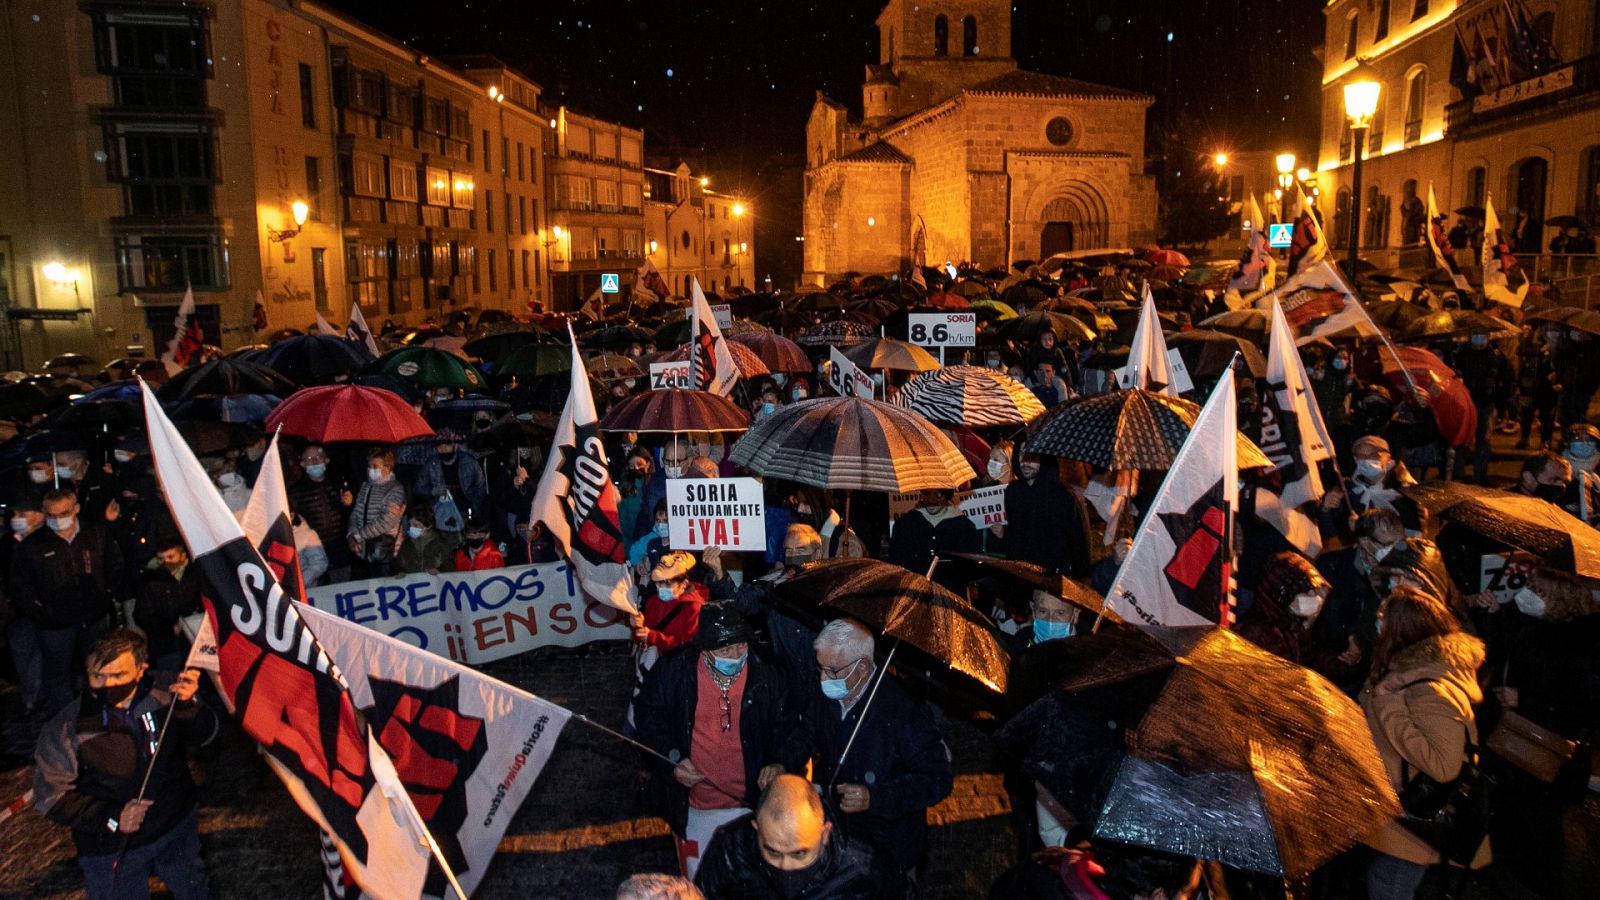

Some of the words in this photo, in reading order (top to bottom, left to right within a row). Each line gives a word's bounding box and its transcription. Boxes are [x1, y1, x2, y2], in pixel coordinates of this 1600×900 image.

[946, 314, 975, 323] SORIA
[910, 323, 948, 345] 8,6
[948, 333, 975, 344] h/km
[662, 367, 689, 378] SOR
[831, 360, 854, 396] 8,6
[853, 367, 873, 391] SORIA
[686, 483, 738, 502] SORIA
[671, 503, 761, 517] ROTUNDAMENTE
[962, 503, 1002, 517] QUIERO
[688, 518, 740, 546] ¡YA!
